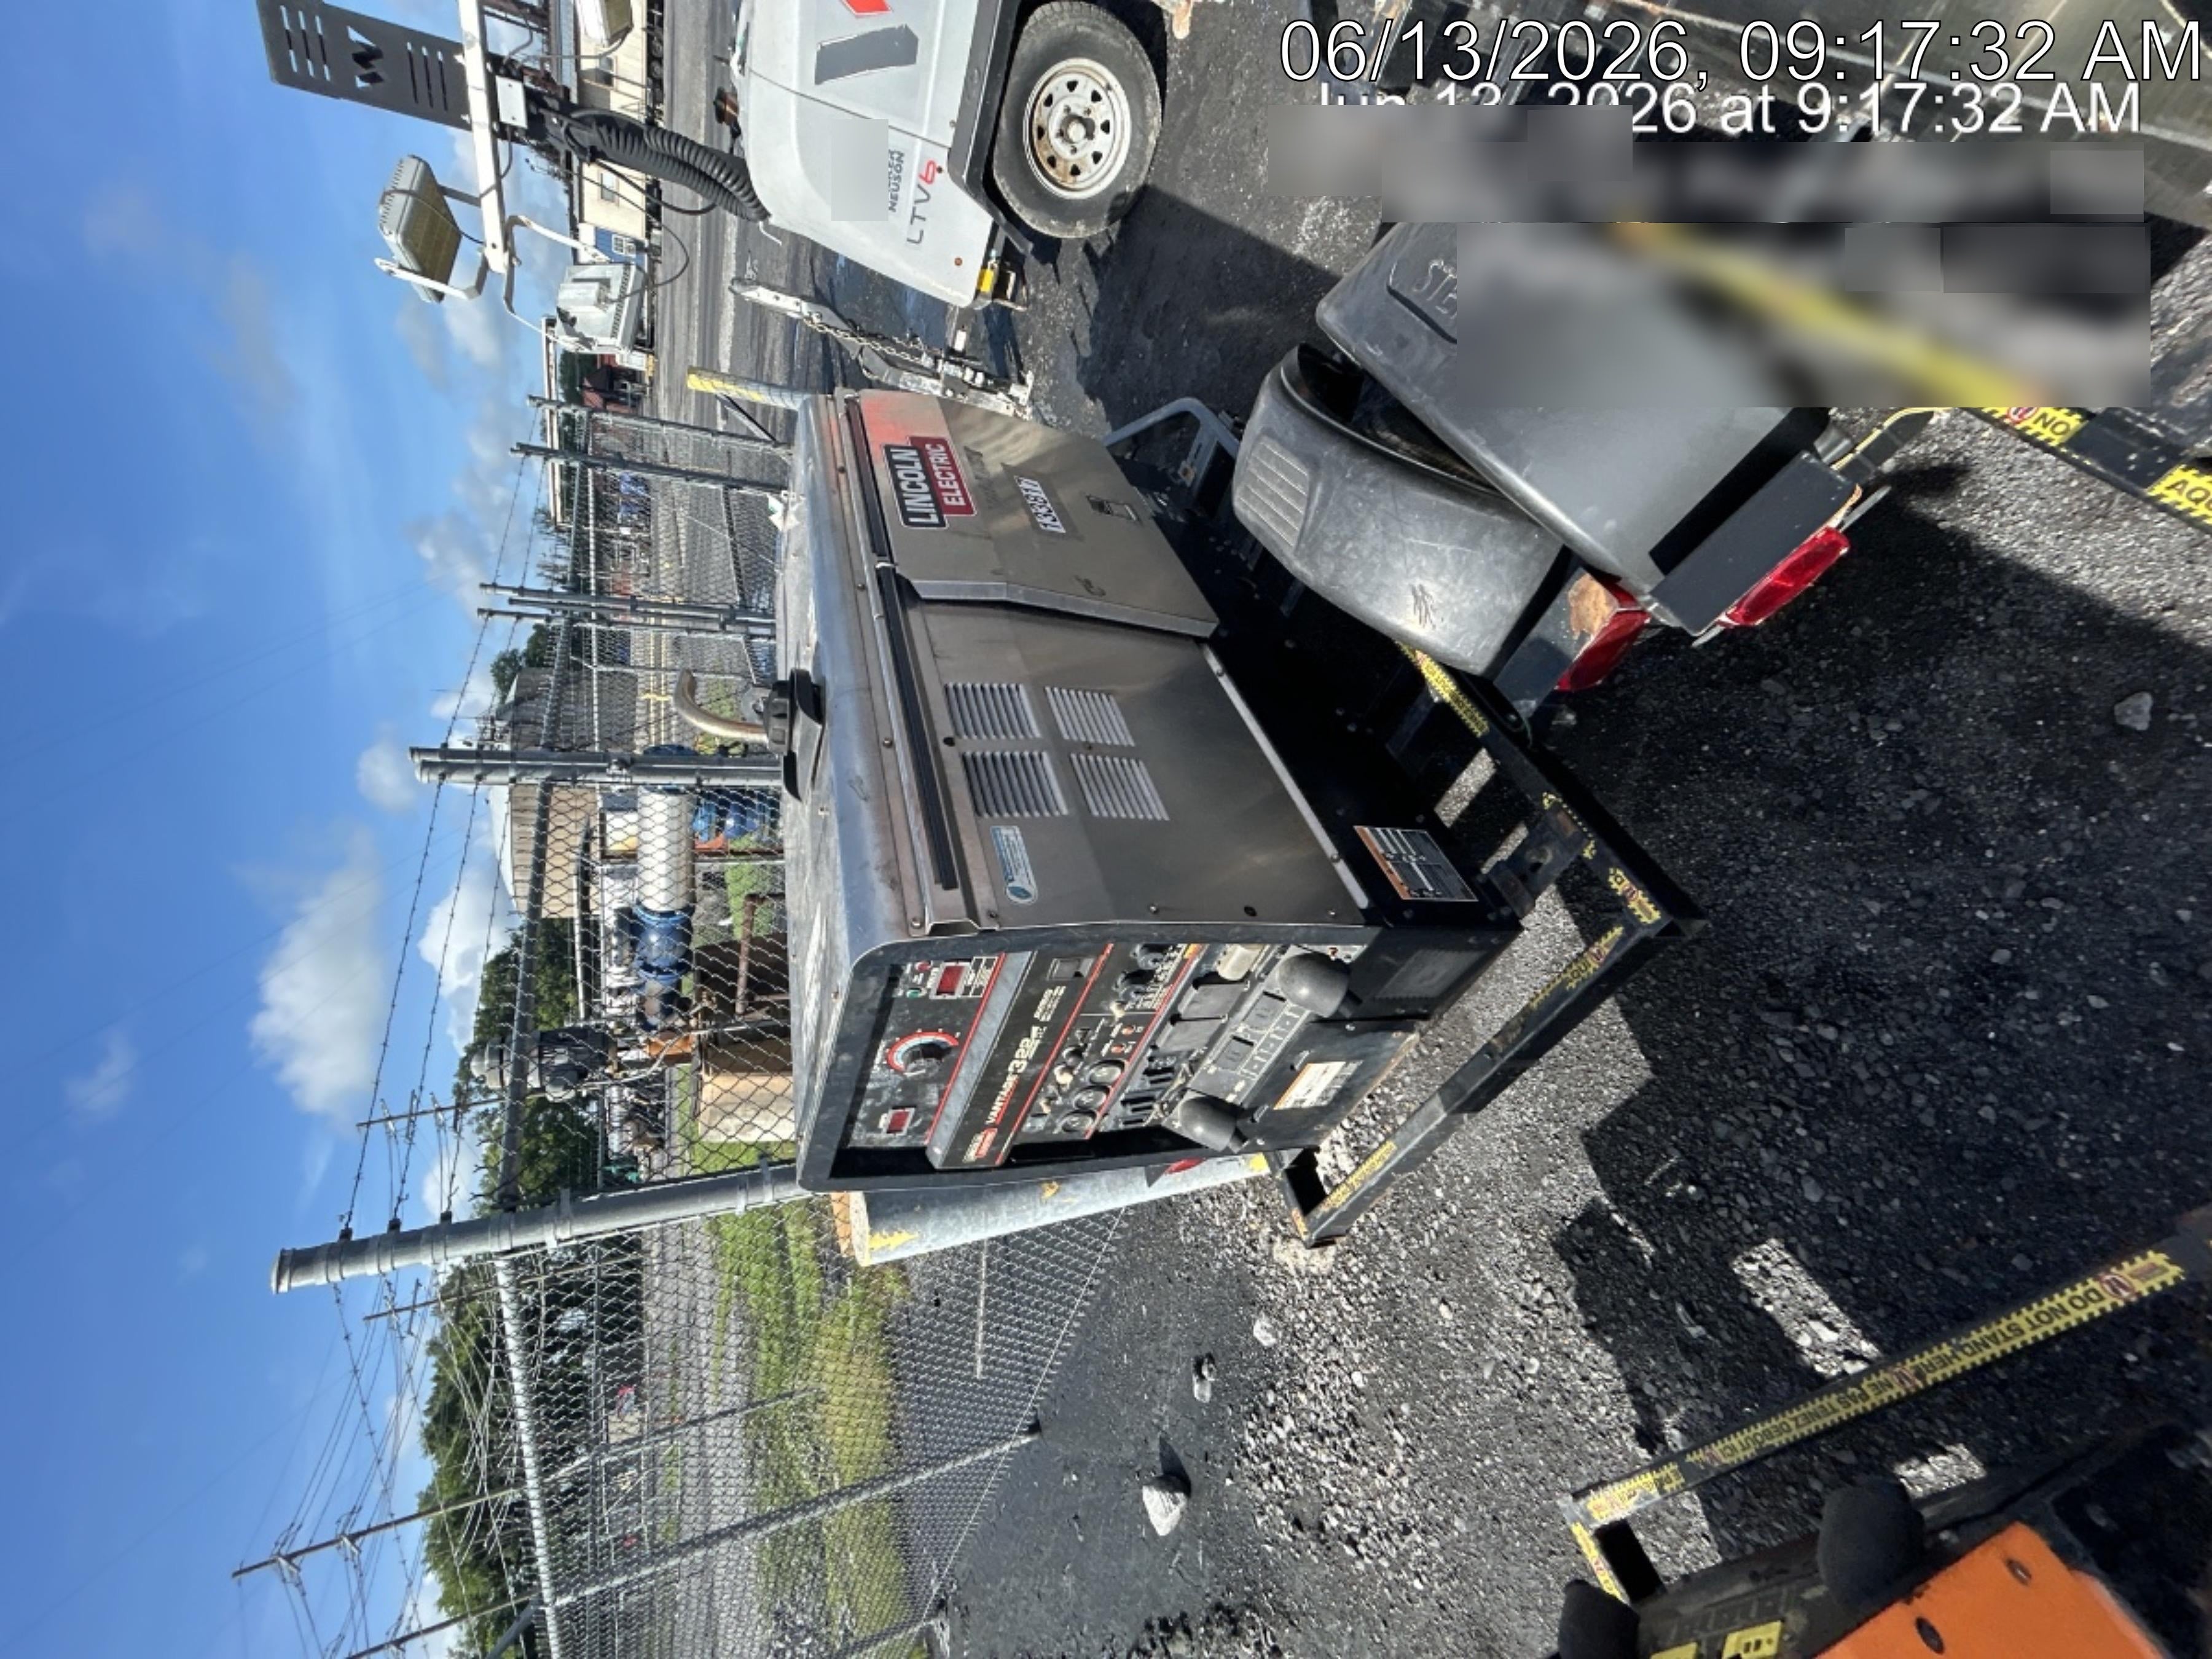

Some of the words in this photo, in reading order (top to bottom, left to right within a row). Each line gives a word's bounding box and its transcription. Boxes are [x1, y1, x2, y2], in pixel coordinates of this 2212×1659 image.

[888, 151, 905, 213] NEUSON
[890, 447, 939, 524] LINCOLN
[925, 443, 967, 506] ELECTRIC
[2028, 1303, 2070, 1331] NOT
[2068, 1288, 2104, 1310] DO
[1963, 1322, 2025, 1357] STAND
